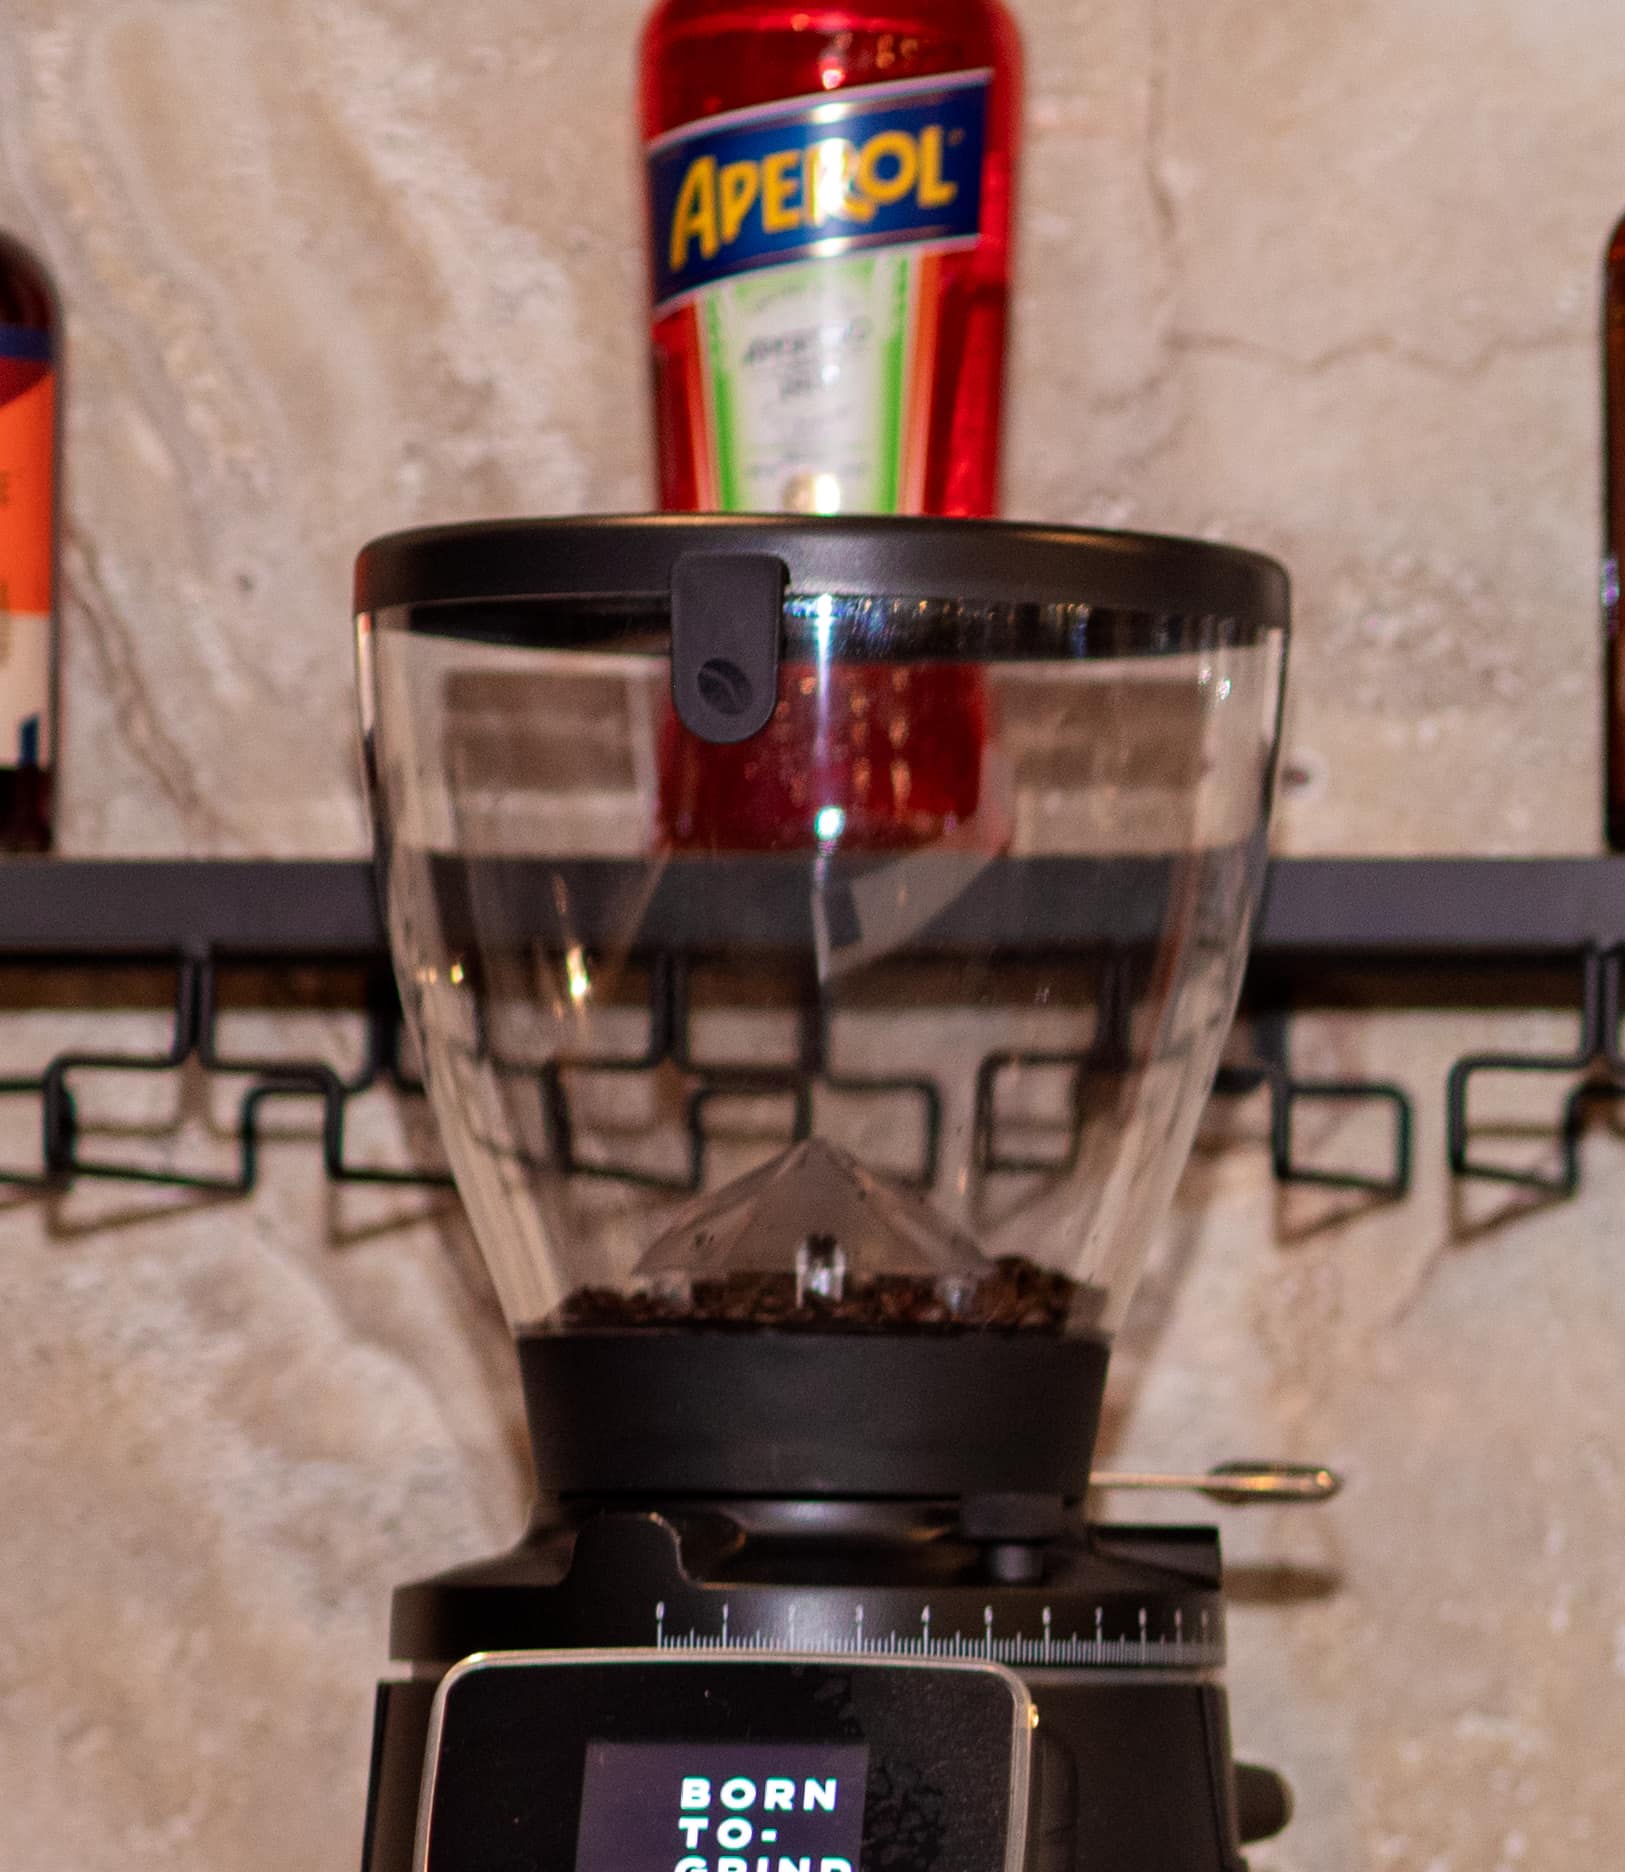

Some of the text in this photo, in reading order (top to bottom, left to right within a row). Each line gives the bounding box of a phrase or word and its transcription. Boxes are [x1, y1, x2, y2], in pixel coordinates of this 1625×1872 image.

[669, 124, 957, 272] APEROL
[680, 1776, 838, 1812] BORN
[678, 1815, 778, 1850] TO-
